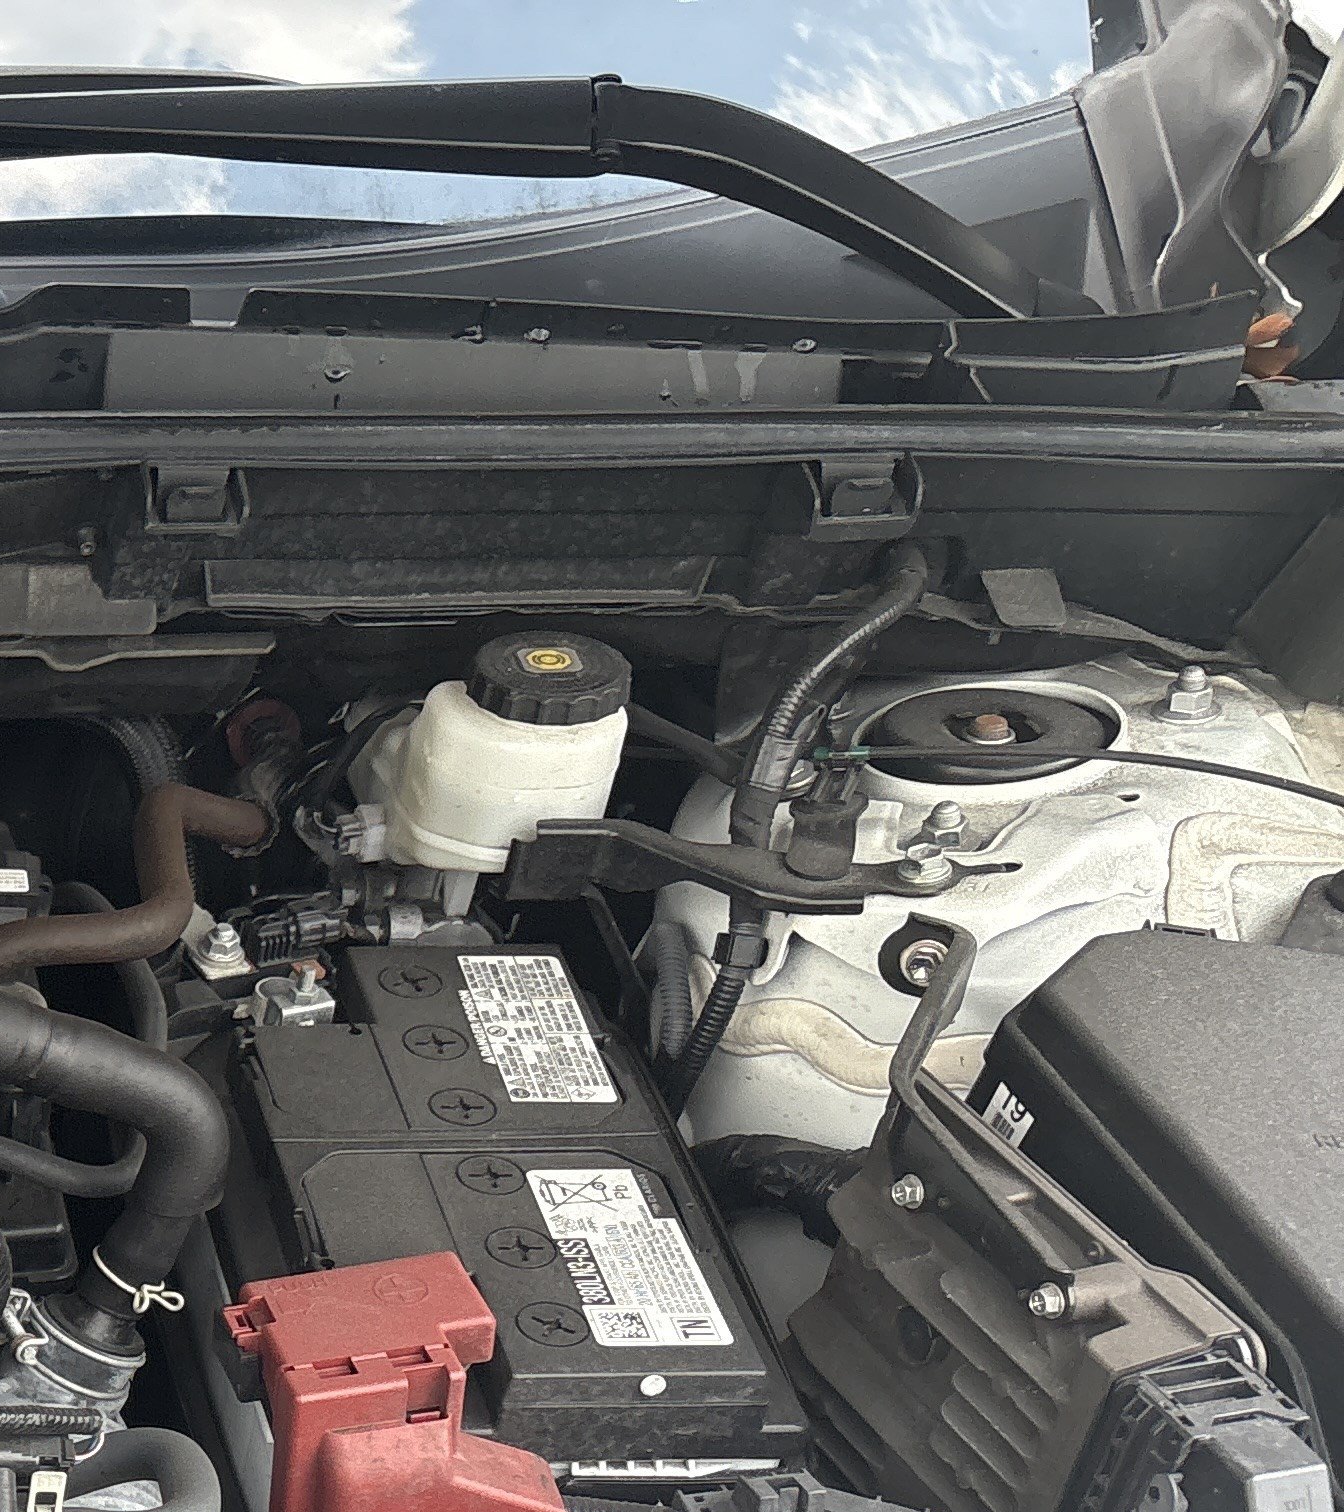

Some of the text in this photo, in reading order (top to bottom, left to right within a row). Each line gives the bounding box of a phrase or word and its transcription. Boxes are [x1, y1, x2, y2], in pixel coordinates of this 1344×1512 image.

[612, 1184, 632, 1200] Pb
[557, 1239, 611, 1305] 380LN3-ISS
[676, 1317, 716, 1340] TN
